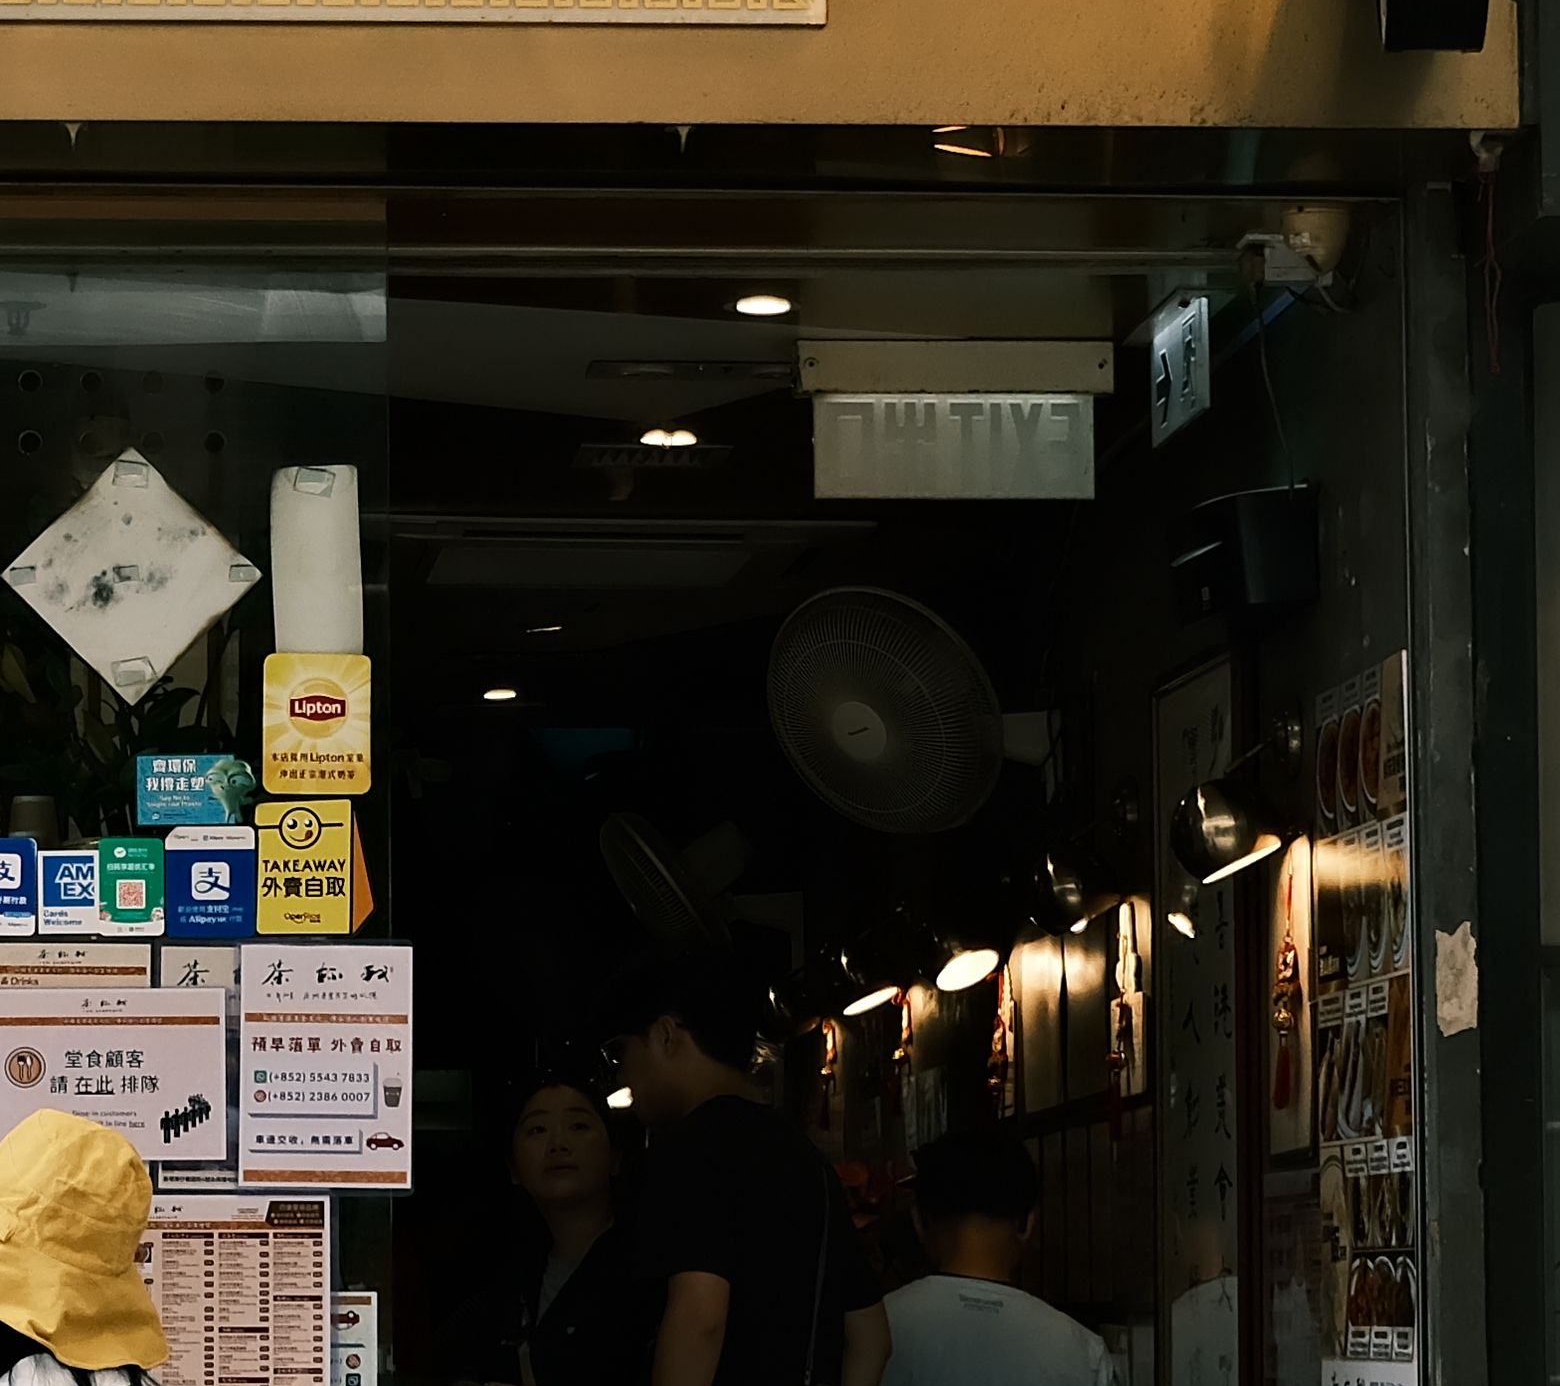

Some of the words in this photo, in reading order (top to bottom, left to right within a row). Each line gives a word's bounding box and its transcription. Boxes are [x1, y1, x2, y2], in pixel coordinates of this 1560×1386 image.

[294, 699, 341, 717] Lipton
[146, 776, 205, 791] 我撐走塑
[262, 859, 346, 873] TAKEAWAY
[262, 876, 346, 898] 外賣自取
[43, 918, 82, 926] Welcome
[251, 1036, 322, 1054] 預早落單
[64, 1049, 145, 1069] 堂食顧客
[50, 1076, 69, 1094] 請
[74, 1075, 115, 1095] 在此
[120, 1075, 160, 1094] 排隊
[268, 1071, 306, 1083] (+852)
[309, 1071, 338, 1082] 5543
[341, 1071, 370, 1082] 7833
[267, 1090, 306, 1103] (+852)
[309, 1091, 338, 1102] 2386
[341, 1091, 371, 1102] 0007
